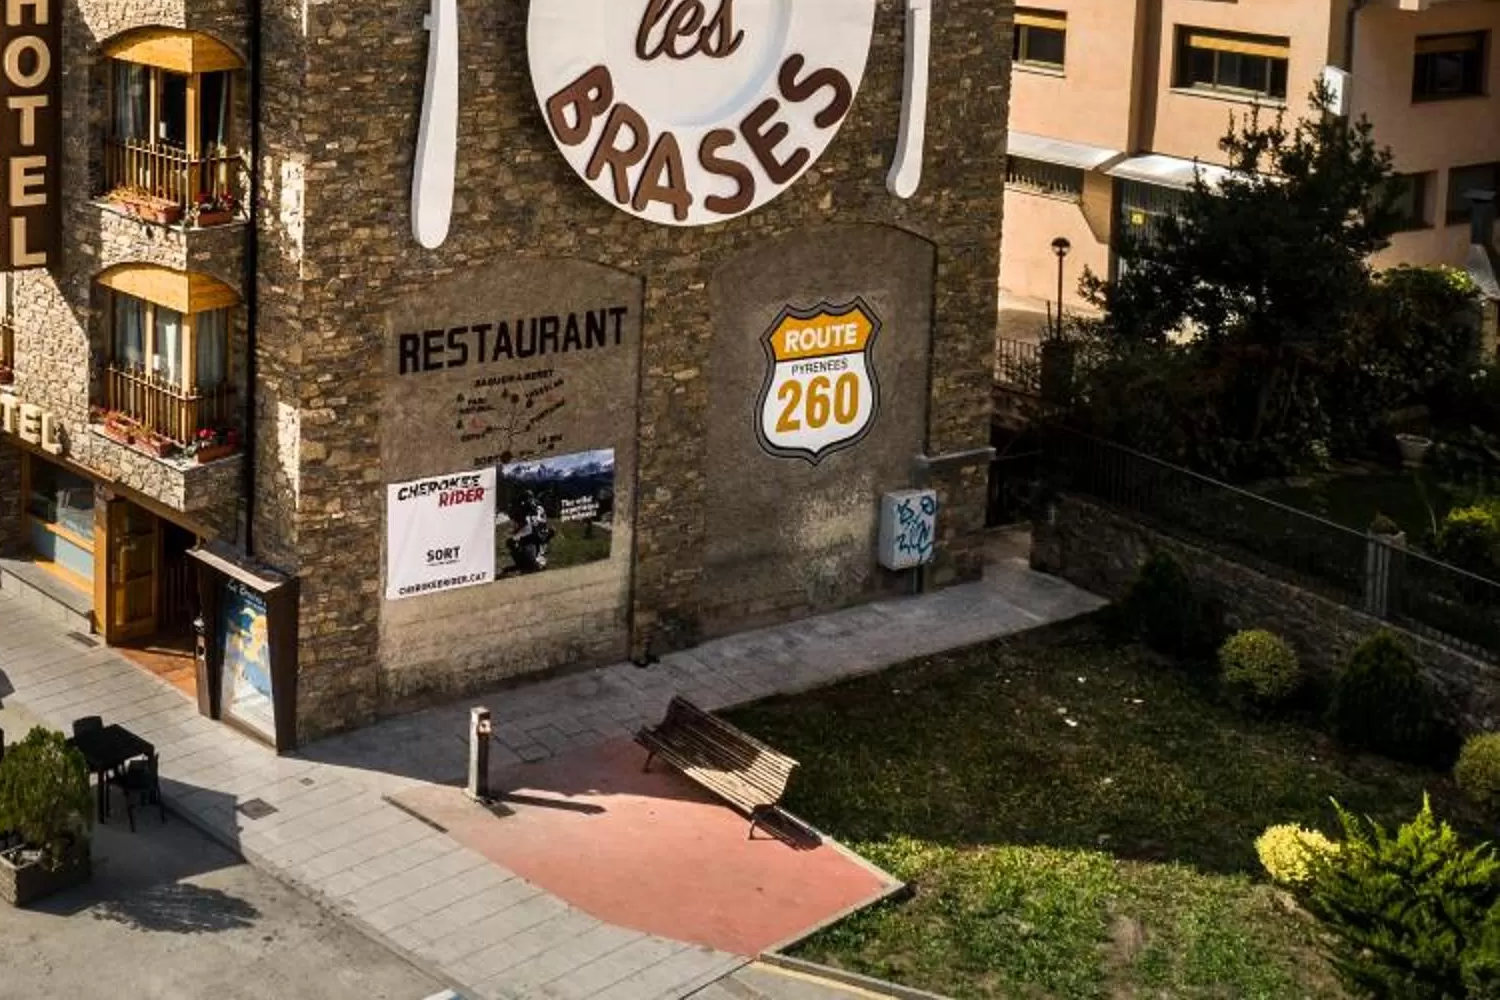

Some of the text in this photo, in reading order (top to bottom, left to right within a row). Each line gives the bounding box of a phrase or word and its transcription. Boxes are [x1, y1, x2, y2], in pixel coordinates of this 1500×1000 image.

[545, 52, 853, 221] BRASES
[398, 306, 628, 375] RESTAURANT
[784, 322, 859, 353] ROUTE
[790, 357, 848, 376] PYRENEES
[775, 371, 860, 434] 260
[397, 475, 482, 501] CHEROKEE
[438, 487, 485, 508] RIDER
[426, 546, 461, 563] SORT
[398, 571, 488, 595] CHEROKEERIDER.CAT
